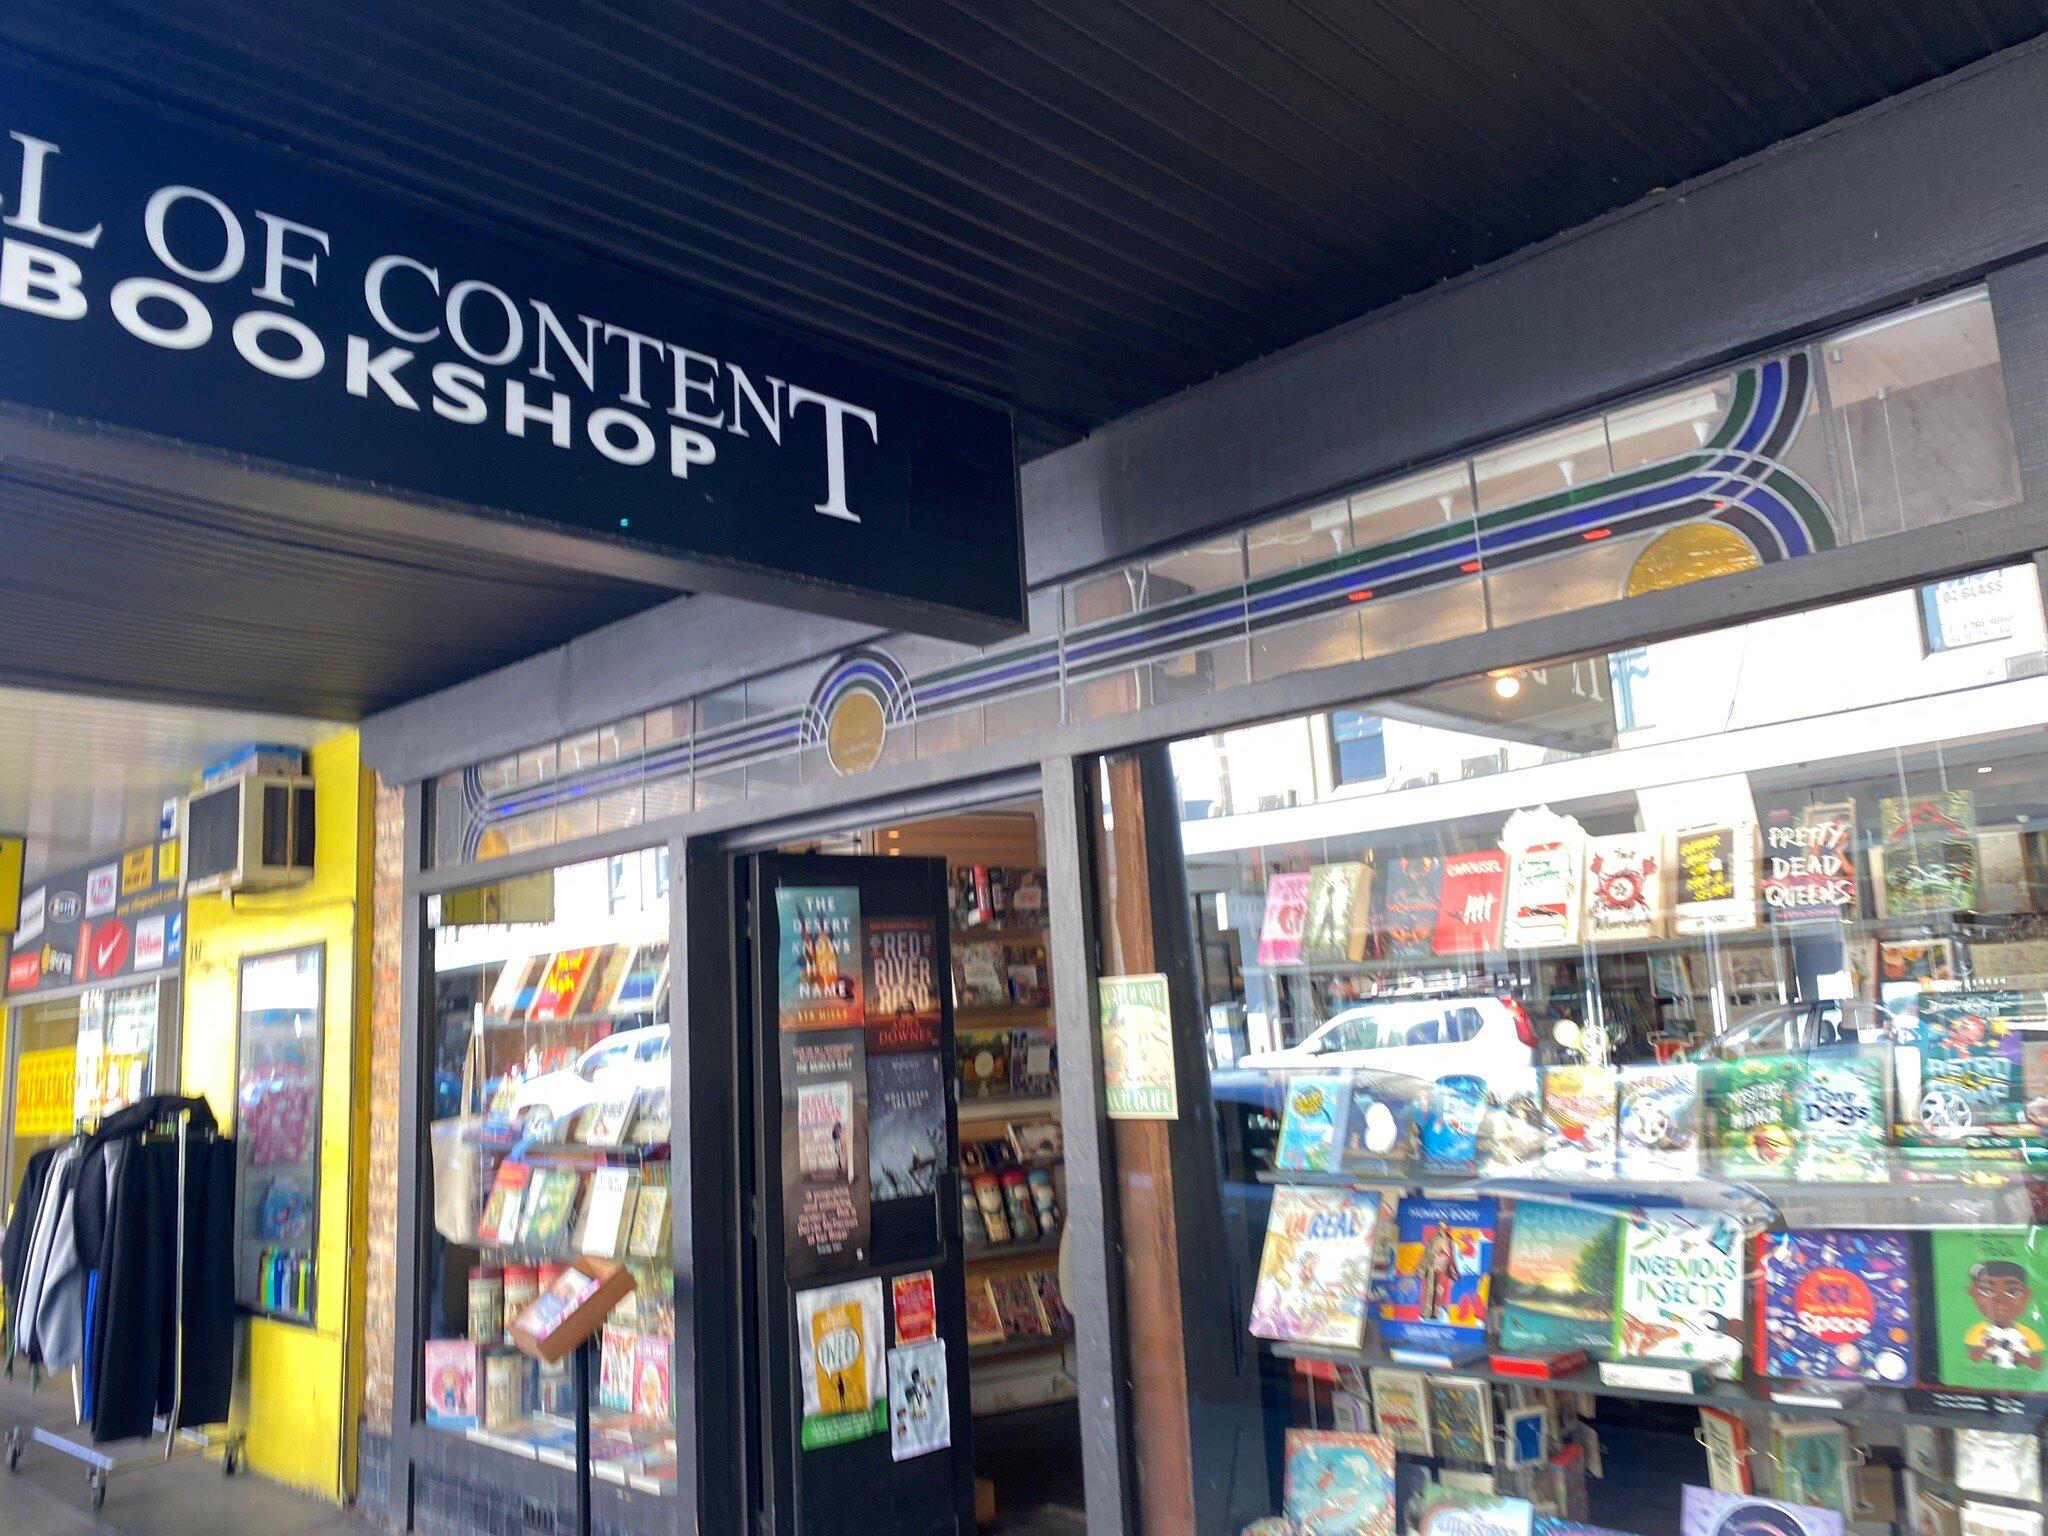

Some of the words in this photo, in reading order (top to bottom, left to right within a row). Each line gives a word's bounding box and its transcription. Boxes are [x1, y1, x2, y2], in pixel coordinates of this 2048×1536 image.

[0, 237, 718, 480] BOOKSHOP
[144, 184, 331, 306] OF
[364, 254, 879, 524] CONTENT
[1767, 821, 1845, 851] PRETTY
[1771, 853, 1842, 879] DEAD
[806, 895, 836, 913] THE
[1764, 878, 1854, 907] QUEENS
[792, 917, 852, 935] DESERT
[883, 931, 921, 958] RED
[874, 957, 932, 987] RIVER
[799, 981, 847, 999] NAME
[879, 980, 930, 1014] ROAD
[1637, 1279, 1727, 1307] INSECTS
